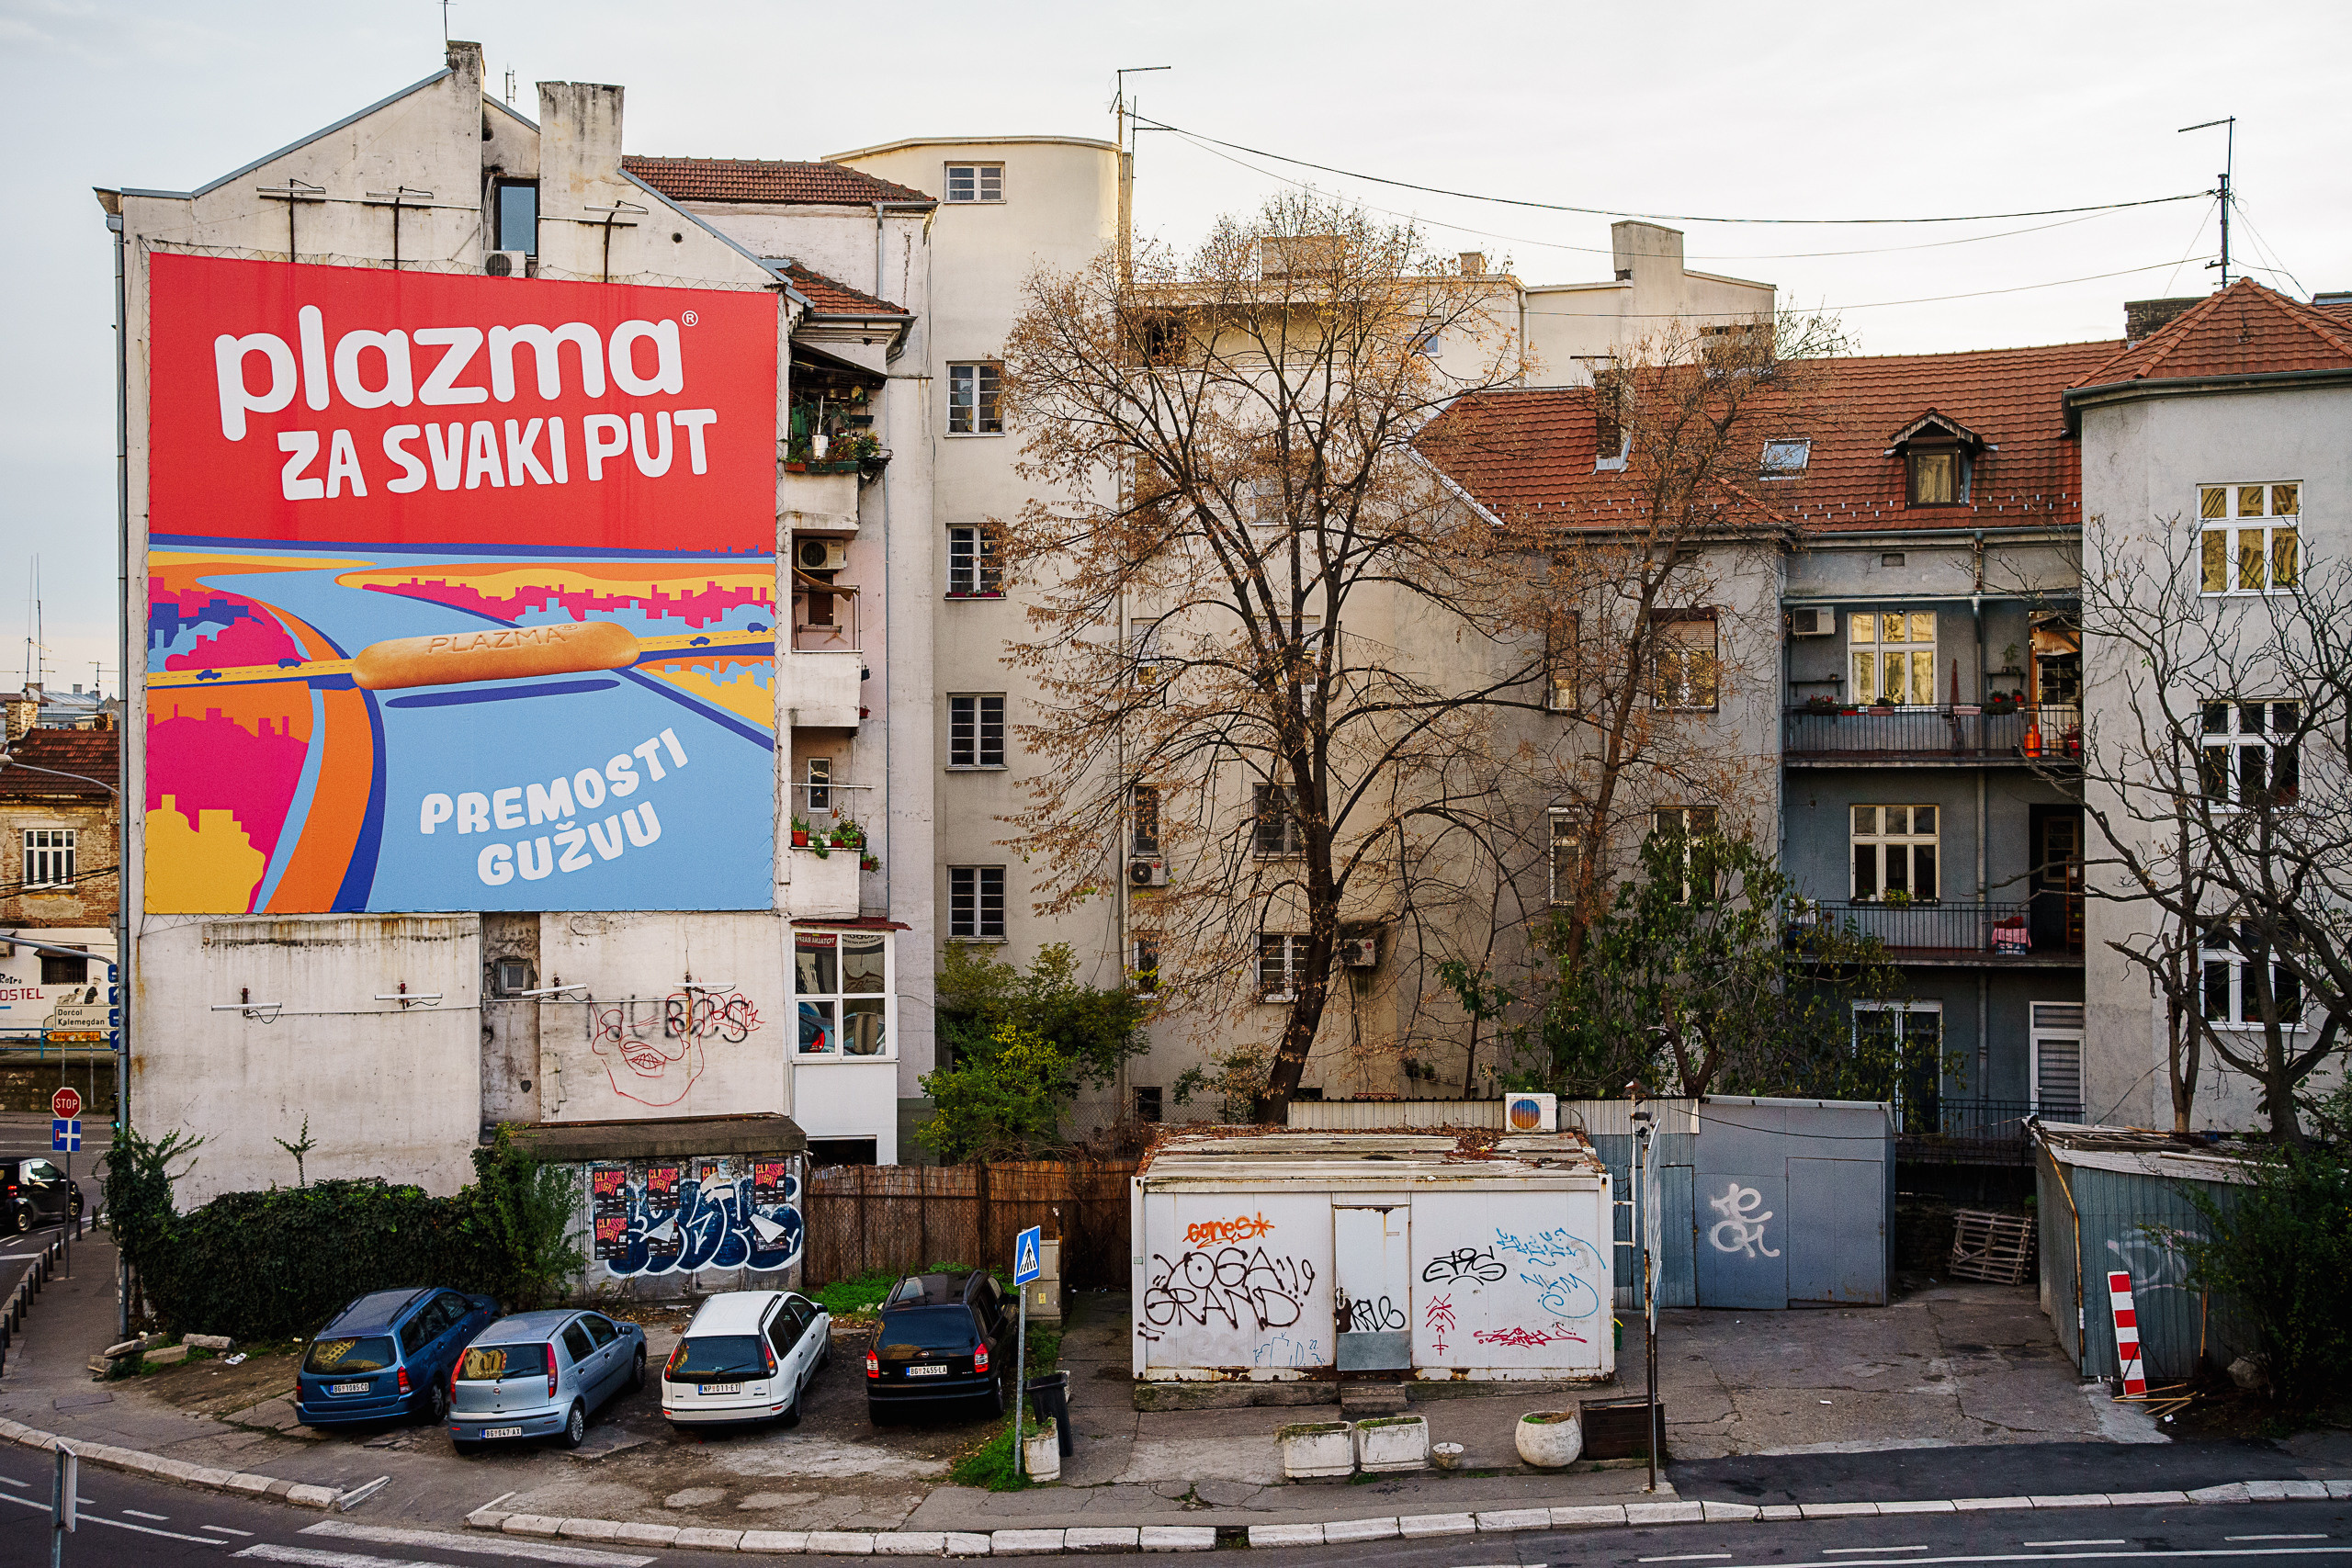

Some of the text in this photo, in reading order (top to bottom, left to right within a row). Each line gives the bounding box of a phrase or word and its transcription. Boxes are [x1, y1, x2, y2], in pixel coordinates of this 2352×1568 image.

[214, 304, 684, 441] plazma
[277, 408, 718, 501] ZA SVAKI PUT
[427, 626, 567, 653] PLAZMA
[420, 727, 689, 835] PREMOSTI
[477, 800, 662, 886] GUŽVU
[58, 1018, 105, 1027] Kalemegdan
[55, 1098, 78, 1110] STOP
[648, 1168, 678, 1182] CLASSIC
[755, 1163, 785, 1177] CLASSIC
[594, 1171, 625, 1185] CLASSIC
[755, 1174, 778, 1188] NIGHT
[594, 1181, 617, 1196] NIGHT
[649, 1179, 671, 1193] NIGHT
[596, 1217, 627, 1232] CLASSIC
[596, 1228, 619, 1243] NIGHT
